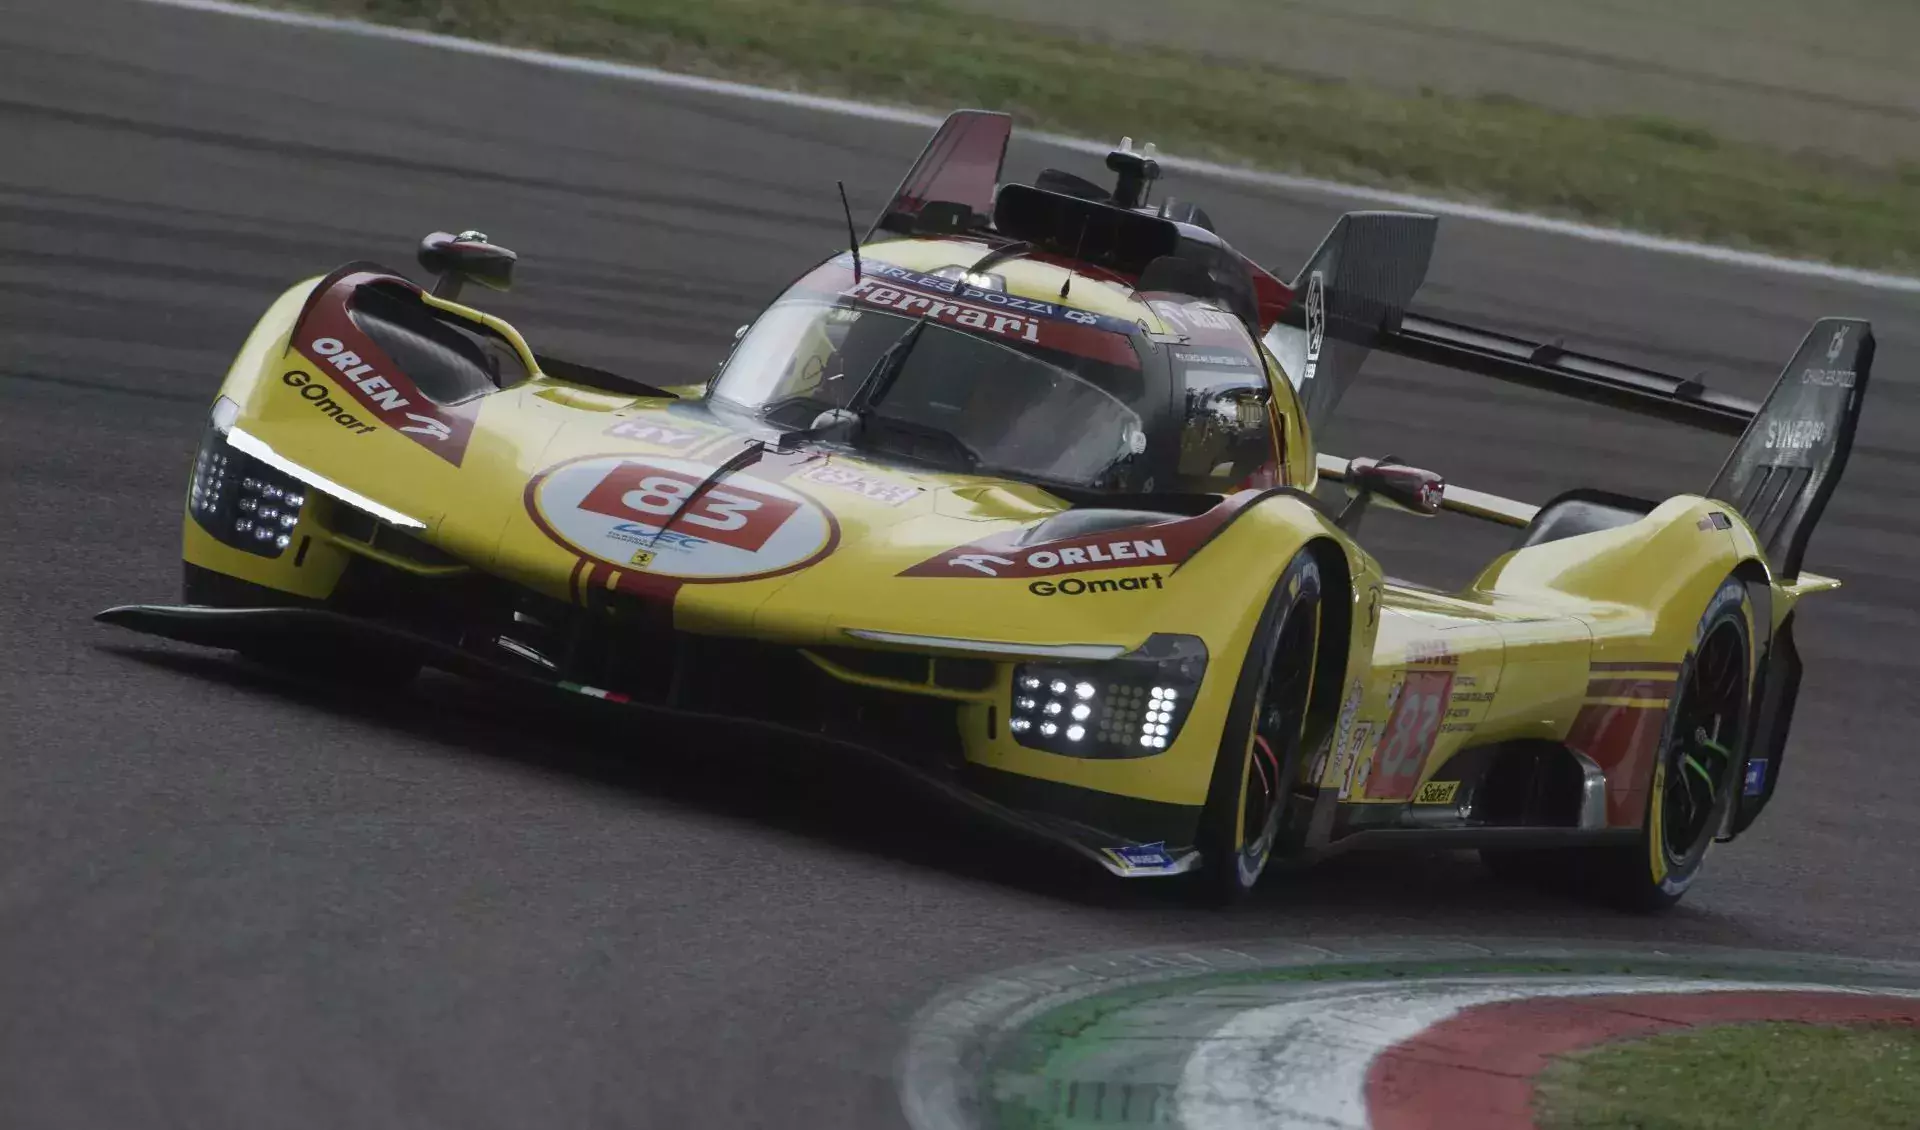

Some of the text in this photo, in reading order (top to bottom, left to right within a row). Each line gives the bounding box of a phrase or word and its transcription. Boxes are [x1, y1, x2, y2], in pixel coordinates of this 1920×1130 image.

[838, 276, 1039, 343] Ferrari
[964, 286, 1053, 314] POZZI
[311, 337, 411, 411] ORLEN
[282, 370, 377, 435] GOmart
[621, 476, 764, 531] 83
[612, 523, 709, 549] WEC
[1027, 538, 1168, 570] ORLEN
[1028, 572, 1164, 597] GOmart
[1379, 692, 1441, 778] 83
